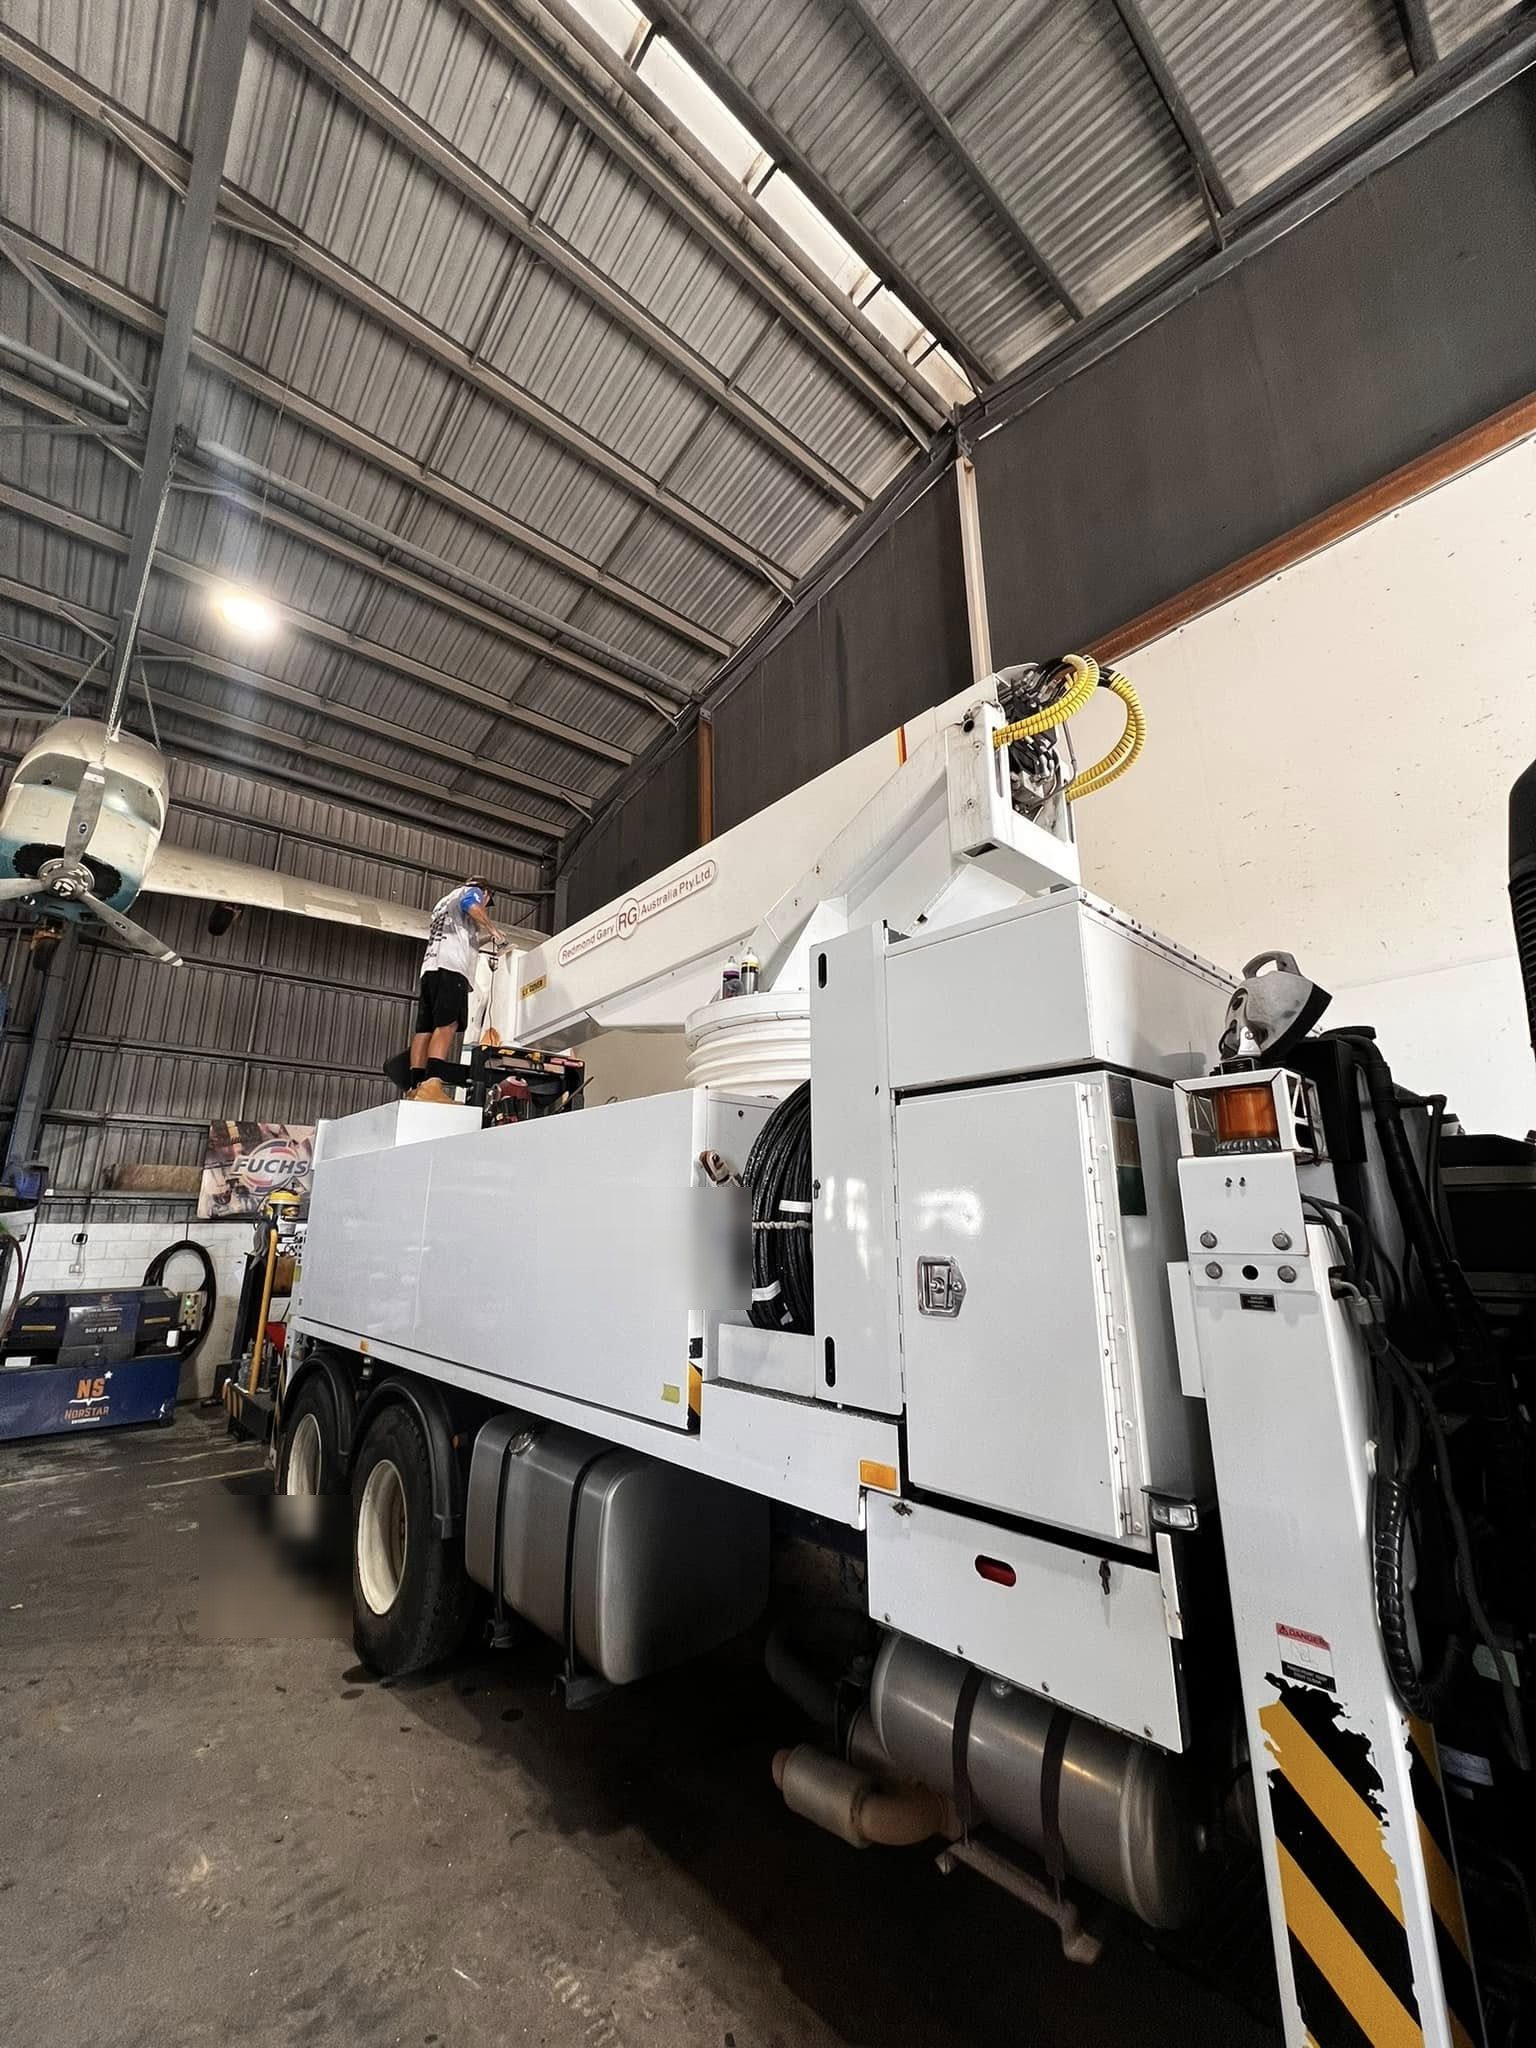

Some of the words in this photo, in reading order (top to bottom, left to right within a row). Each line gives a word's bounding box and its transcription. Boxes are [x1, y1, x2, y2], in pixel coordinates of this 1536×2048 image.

[562, 933, 597, 961] Redmond
[596, 923, 615, 941] Gary
[618, 906, 638, 931] RG
[641, 887, 678, 916] Australia
[234, 1158, 308, 1175] FUCHS
[76, 1377, 105, 1398] NS
[1288, 1628, 1328, 1647] DANGER
